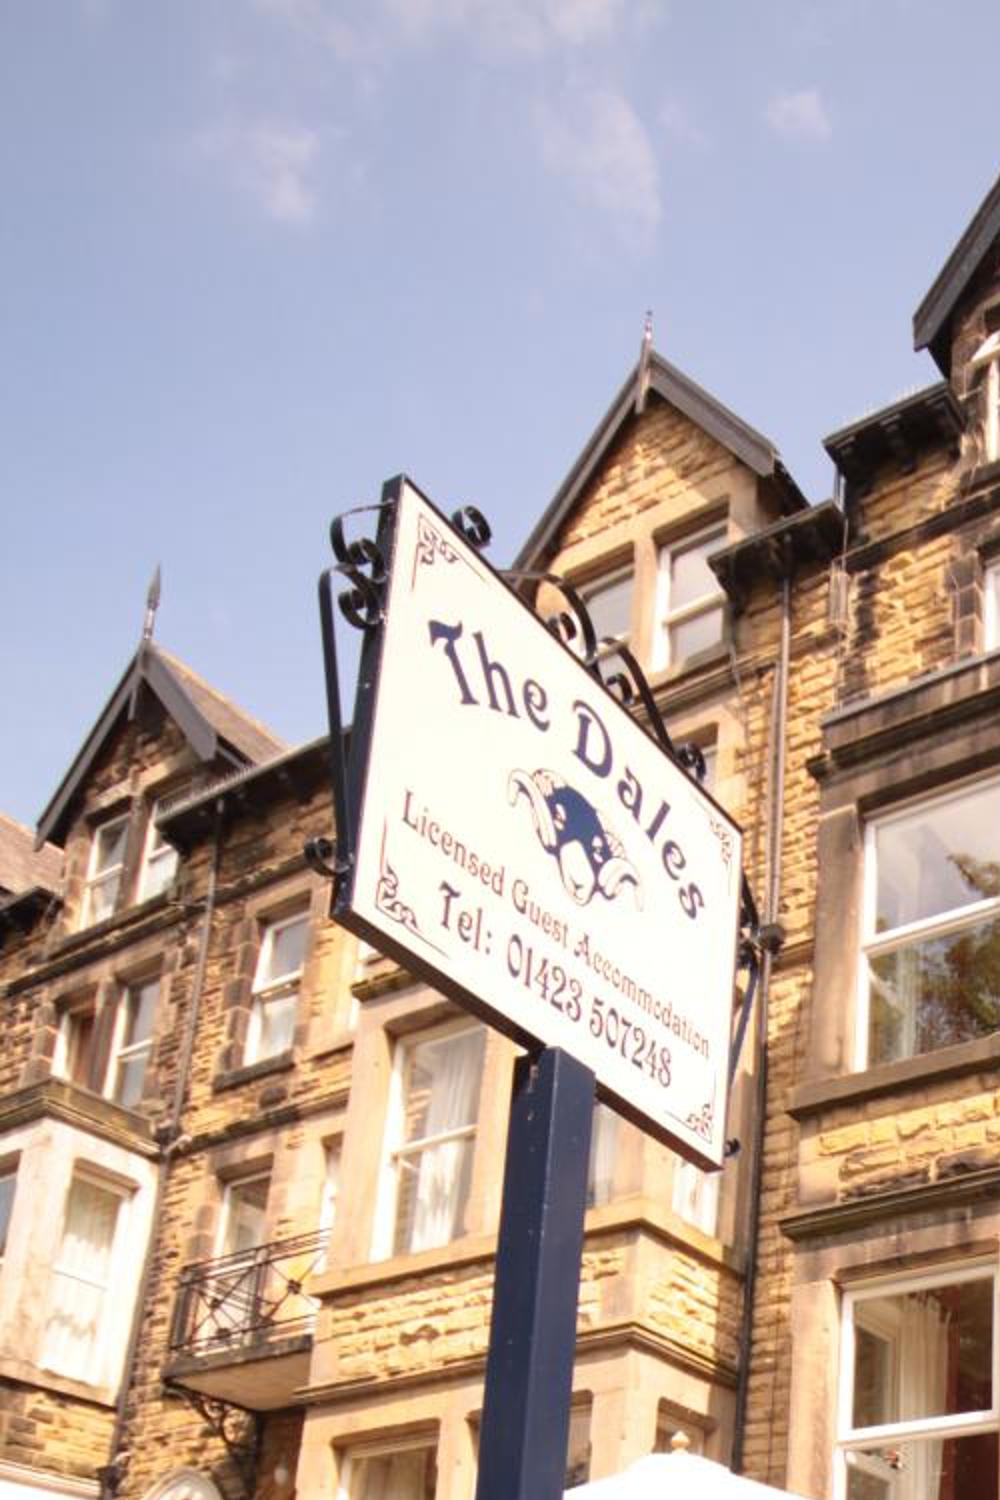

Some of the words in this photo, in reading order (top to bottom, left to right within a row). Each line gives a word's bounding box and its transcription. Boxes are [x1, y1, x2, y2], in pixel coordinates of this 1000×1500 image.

[428, 620, 550, 732] The
[572, 699, 705, 919] Dales
[402, 788, 505, 896] Licensed
[511, 879, 568, 949] Guest
[573, 932, 710, 1059] Accommodation
[439, 880, 492, 955] Tel:
[507, 933, 583, 1022] 01423
[589, 997, 672, 1088] 507248
